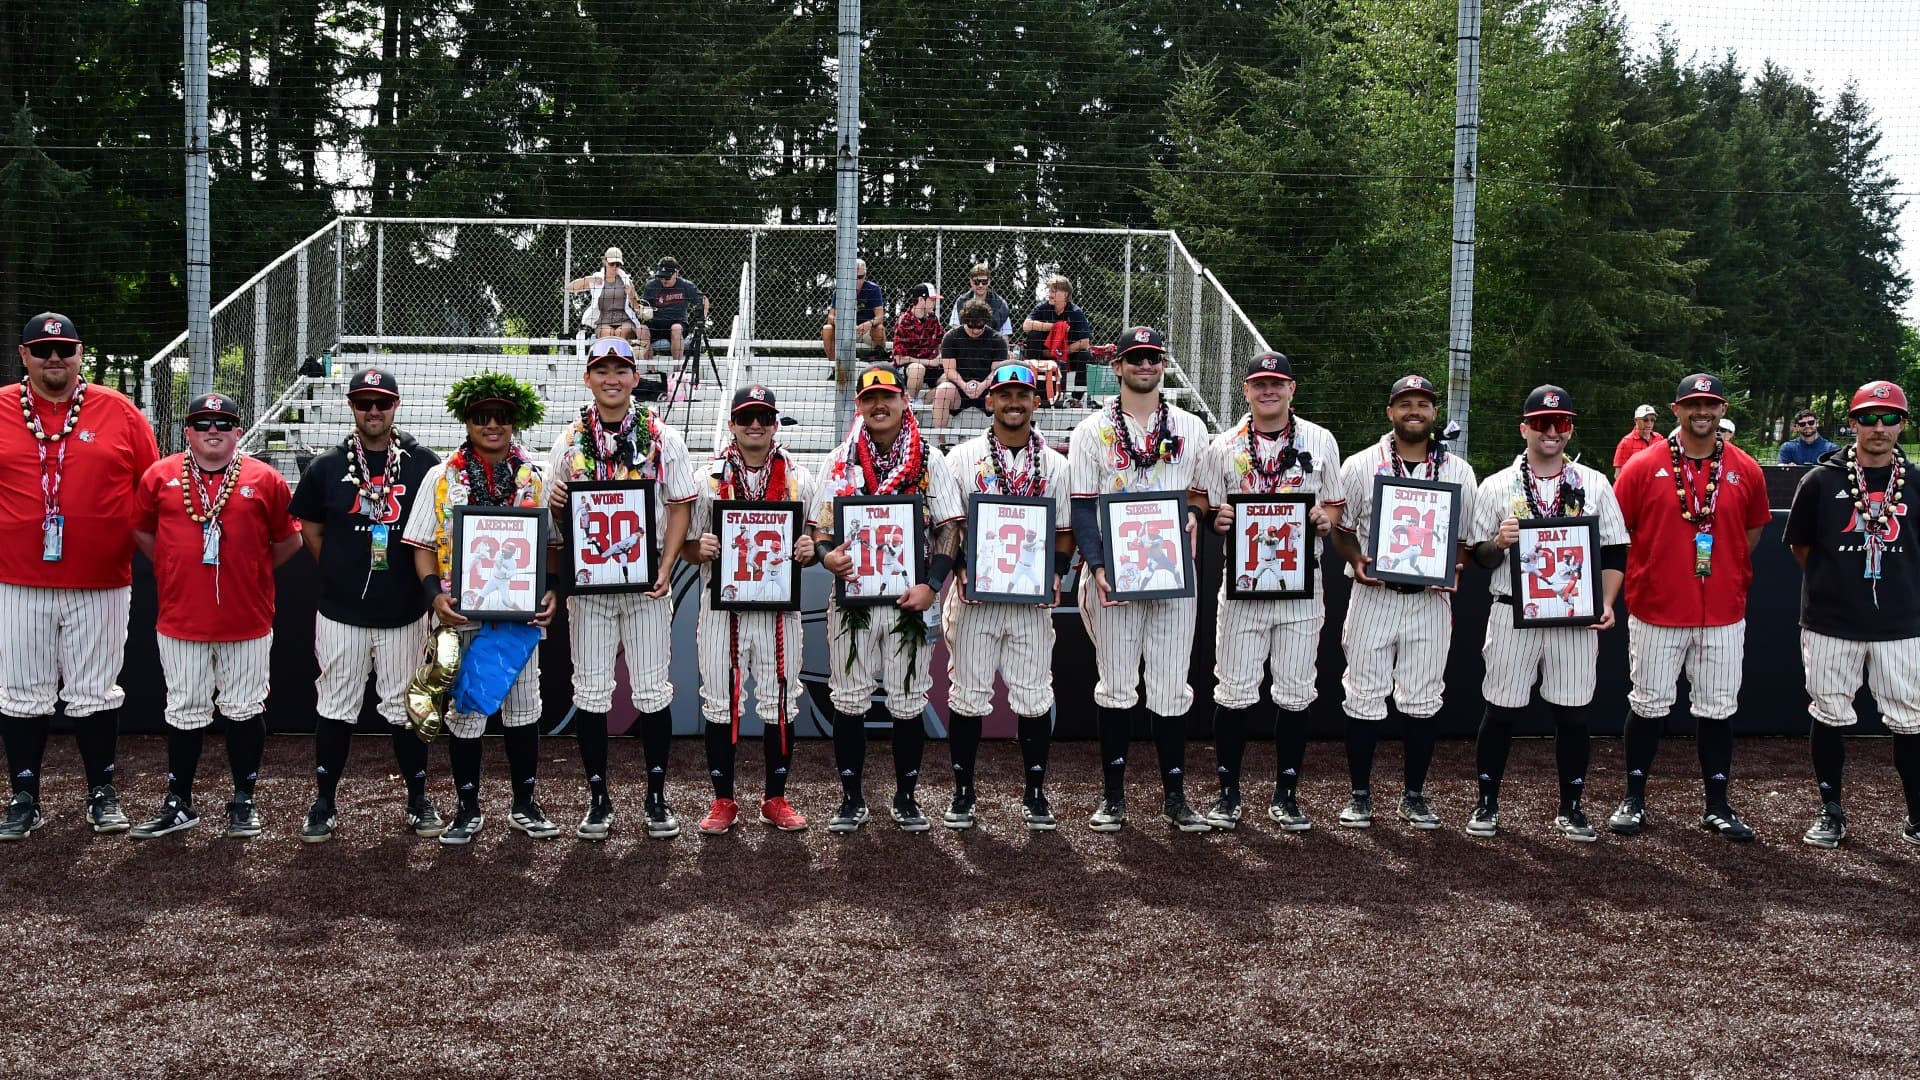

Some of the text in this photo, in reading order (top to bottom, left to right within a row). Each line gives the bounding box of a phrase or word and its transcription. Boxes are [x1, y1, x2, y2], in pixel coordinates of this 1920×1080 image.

[591, 493, 624, 506] WONG
[1246, 504, 1295, 517] SCHABOT
[1394, 488, 1428, 502] SCOTT
[727, 512, 788, 525] STASZKOW
[866, 507, 890, 519] TOM
[581, 511, 641, 565] 30
[1118, 519, 1178, 571] 35
[1245, 522, 1299, 571] 14
[1390, 506, 1436, 557] 21
[1537, 529, 1568, 542] BRAY
[469, 536, 531, 591] 22
[997, 524, 1026, 574] 3
